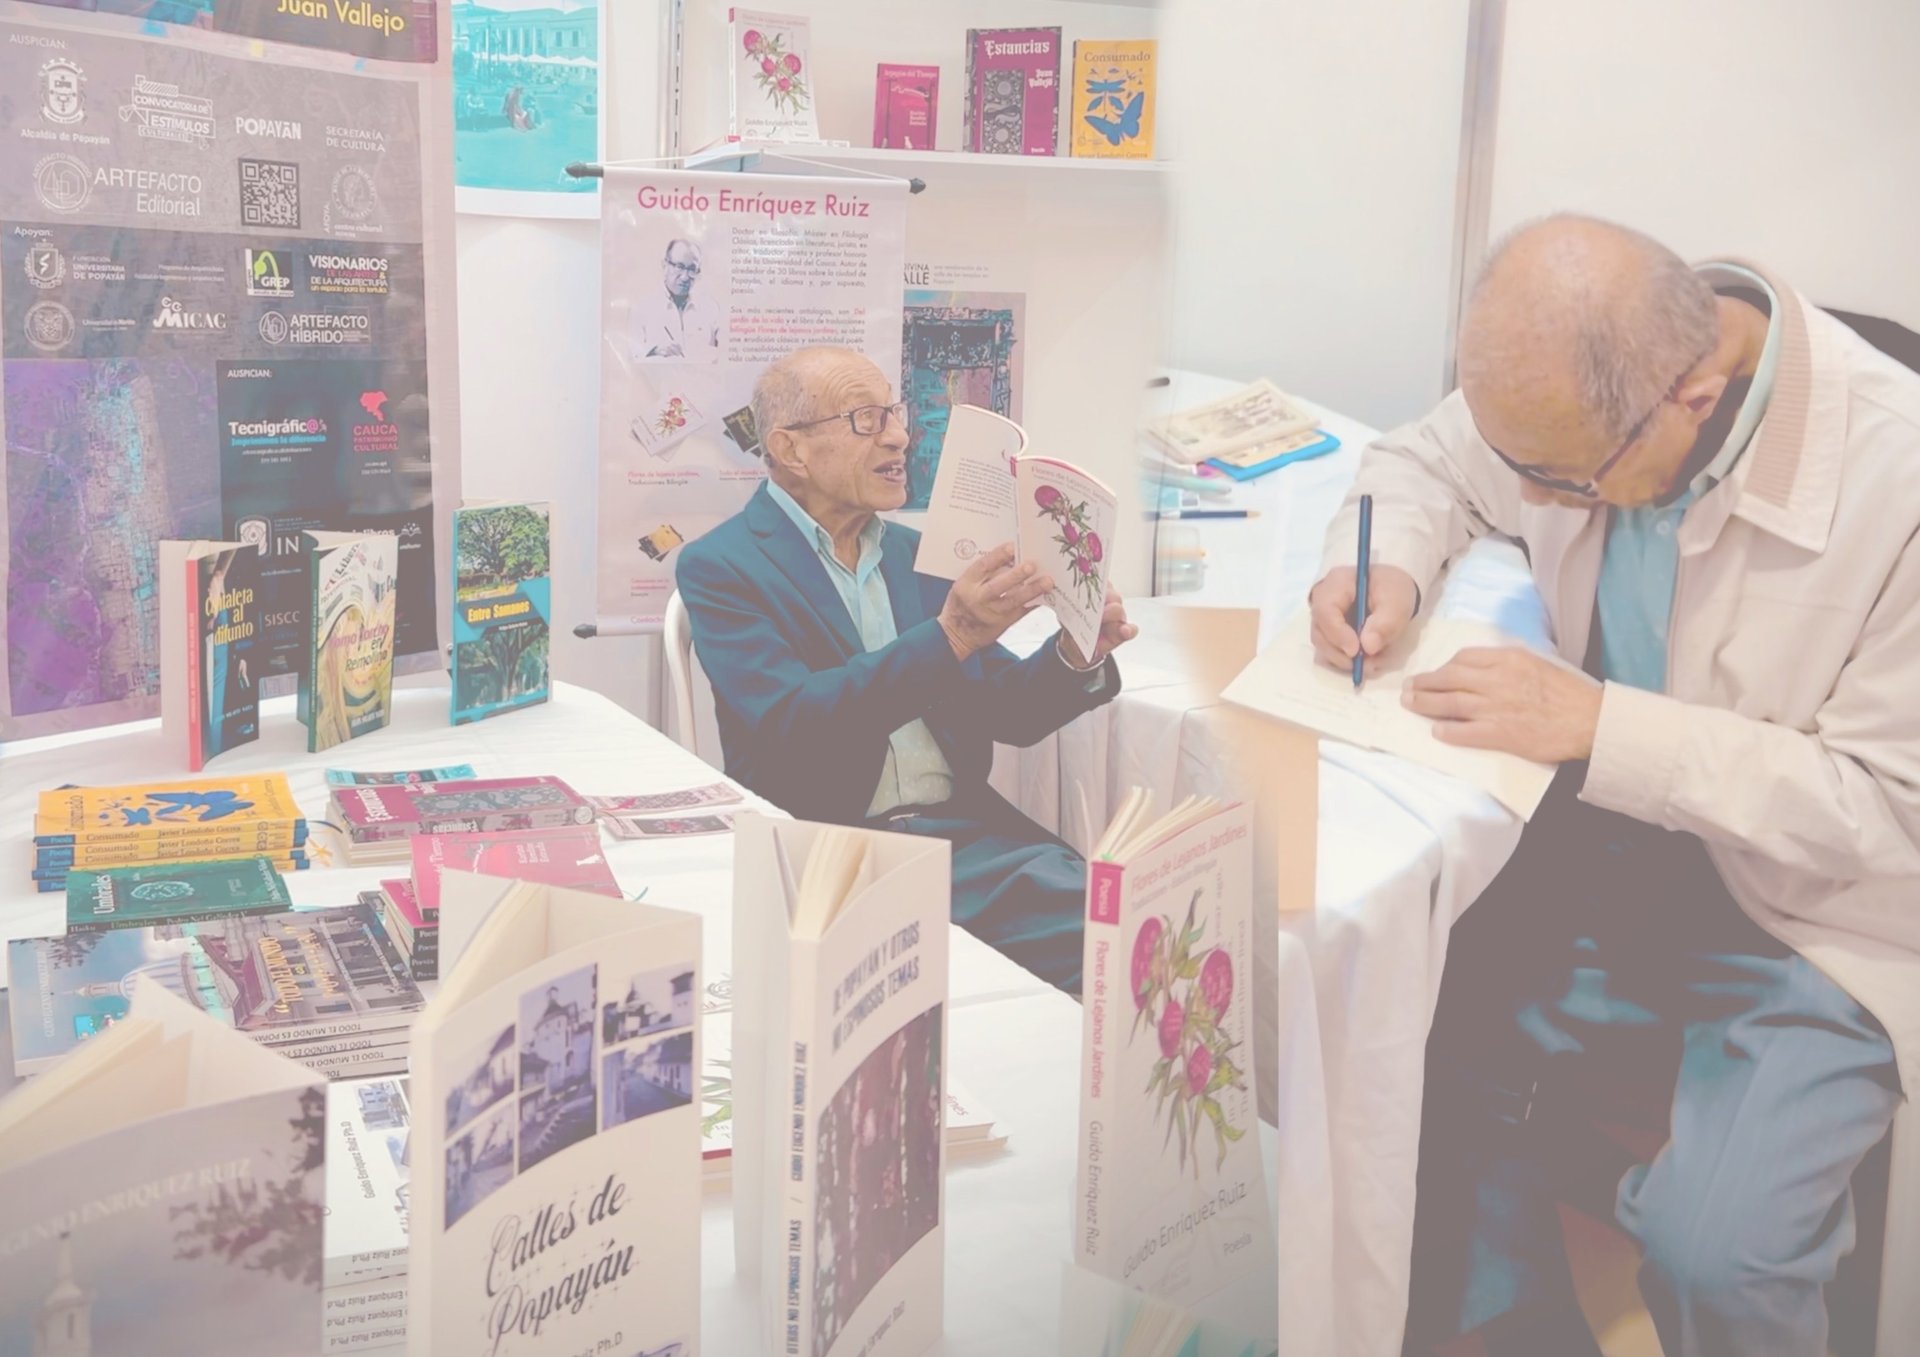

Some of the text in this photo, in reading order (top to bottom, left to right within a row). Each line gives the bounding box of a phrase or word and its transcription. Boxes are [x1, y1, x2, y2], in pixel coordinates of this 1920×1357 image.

[277, 0, 405, 37] Juan Vallejo
[9, 33, 69, 51] AUSPICIAN:
[984, 40, 1050, 59] Estancias
[1084, 51, 1151, 62] Consumado
[135, 95, 209, 114] CONVOCATORIA DE
[151, 114, 211, 134] ESTÍMULOS
[20, 128, 111, 145] Alcaldía de Popayán
[325, 125, 384, 142] SECRETARÍA
[326, 137, 386, 152] DE CULTURA
[94, 167, 202, 194] ARTEFACTO
[136, 193, 201, 217] Editorial
[637, 186, 870, 221] Guido Enríquez Ruiz
[14, 226, 53, 240] Apoyan:
[732, 227, 754, 235] Doctor
[309, 255, 388, 272] VISIONARIOS
[762, 258, 802, 266] Universidad
[73, 272, 86, 280] DE
[261, 276, 290, 288] GREP
[311, 277, 388, 287] DE LA ARQUITECTURA
[290, 314, 368, 329] ARTEFACTO
[290, 327, 343, 344] HÍBRIDO
[227, 368, 272, 378] AUSPICIAN:
[353, 425, 398, 436] CAUCA
[353, 443, 399, 451] CULTURAL
[233, 602, 244, 624] al
[468, 606, 491, 623] Entre
[214, 621, 254, 647] difunto
[86, 824, 241, 842] Consumado Javier Londoño Correa
[85, 844, 139, 854] Consumado
[158, 841, 180, 849] Javier
[1131, 823, 1248, 894] Flores de Lejanos Jardines
[91, 874, 115, 914] Umbrales
[1098, 877, 1113, 916] Poesía
[890, 920, 921, 960] OTROS
[888, 954, 920, 999] TEMAS
[1090, 940, 1110, 1098] Flores de Lejanos Jardines
[293, 1028, 326, 1037] MUNDO
[339, 1024, 361, 1032] TODO
[304, 1044, 337, 1053] MUNDO
[350, 1040, 371, 1049] TODO
[316, 1057, 350, 1067] MUNDO
[362, 1051, 384, 1060] TODO
[199, 1157, 251, 1187] RUIZ
[364, 1177, 376, 1199] Guido
[1085, 1120, 1104, 1256] Guido Enriquez Ruiz
[485, 1174, 627, 1298] Calles de
[788, 1219, 802, 1251] TEMAS
[1123, 1181, 1248, 1279] Guido Enriquez Ruiz
[348, 1296, 365, 1306] Ruiz
[367, 1290, 404, 1304] Enriquez
[486, 1239, 635, 1357] Popayán
[348, 1314, 365, 1324] Ruiz
[367, 1309, 404, 1323] Enriquez
[786, 1305, 800, 1323] NO
[351, 1332, 369, 1343] Ruiz
[370, 1327, 407, 1341] Enriquez
[597, 1331, 623, 1352] Ph.D
